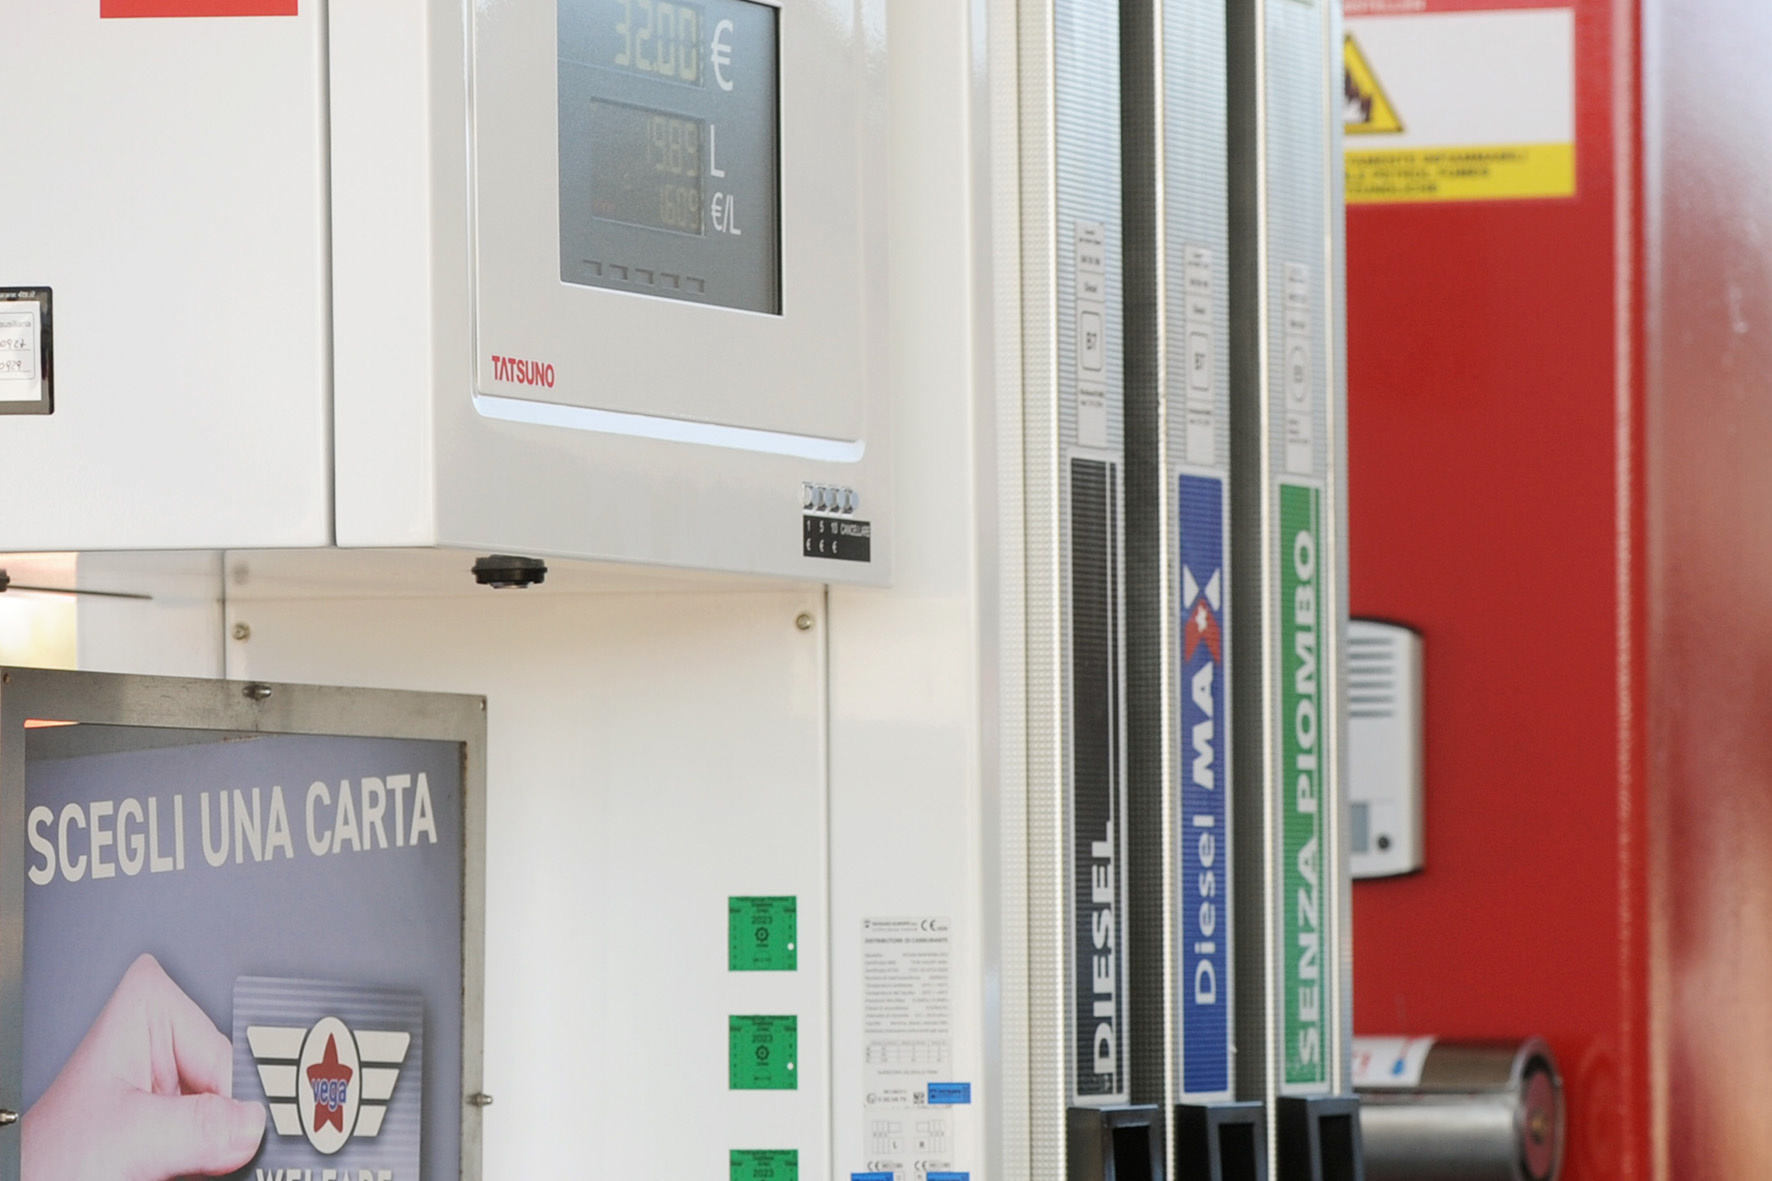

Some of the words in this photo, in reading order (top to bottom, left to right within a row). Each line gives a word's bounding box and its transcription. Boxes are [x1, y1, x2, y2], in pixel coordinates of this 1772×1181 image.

[710, 18, 734, 92] €
[710, 123, 726, 178] L
[491, 354, 555, 388] TATSUNO
[819, 520, 825, 533] 5
[1294, 529, 1318, 814] PIOMBO
[27, 794, 186, 886] SCEGLI
[200, 785, 295, 868] UNA
[305, 772, 438, 856] CARTA
[1091, 820, 1114, 1074] DIESEL
[1193, 814, 1217, 1006] Diesel
[1296, 838, 1320, 1065] SENZA
[311, 1077, 348, 1112] vega
